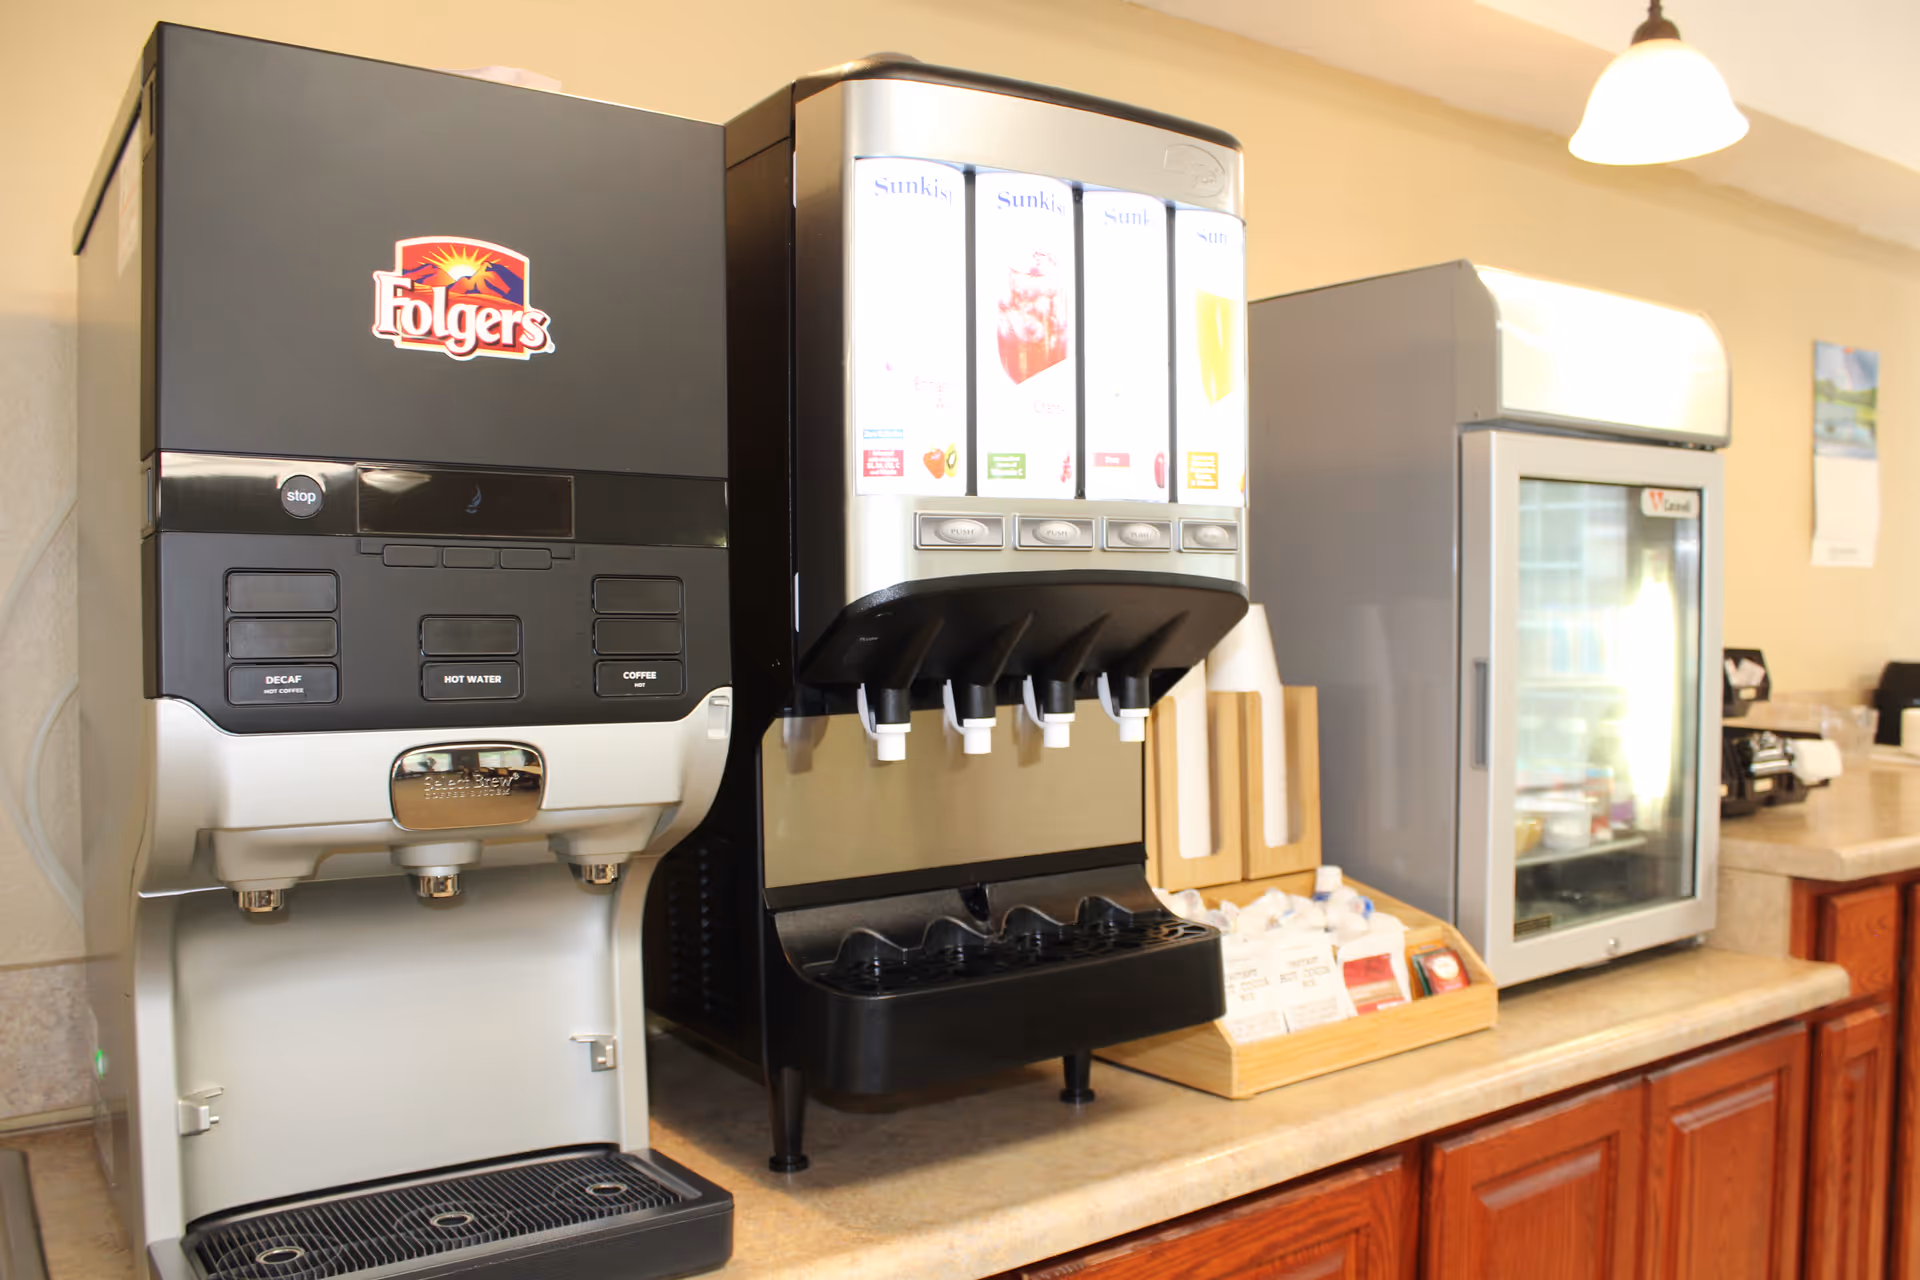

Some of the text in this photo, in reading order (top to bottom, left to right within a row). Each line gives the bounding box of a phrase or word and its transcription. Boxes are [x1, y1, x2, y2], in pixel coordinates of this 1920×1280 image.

[374, 272, 549, 355] Folgers
[286, 490, 316, 504] stop
[264, 675, 302, 685] DECAF
[443, 675, 502, 684] HOT WATER
[622, 671, 657, 680] COFFEE
